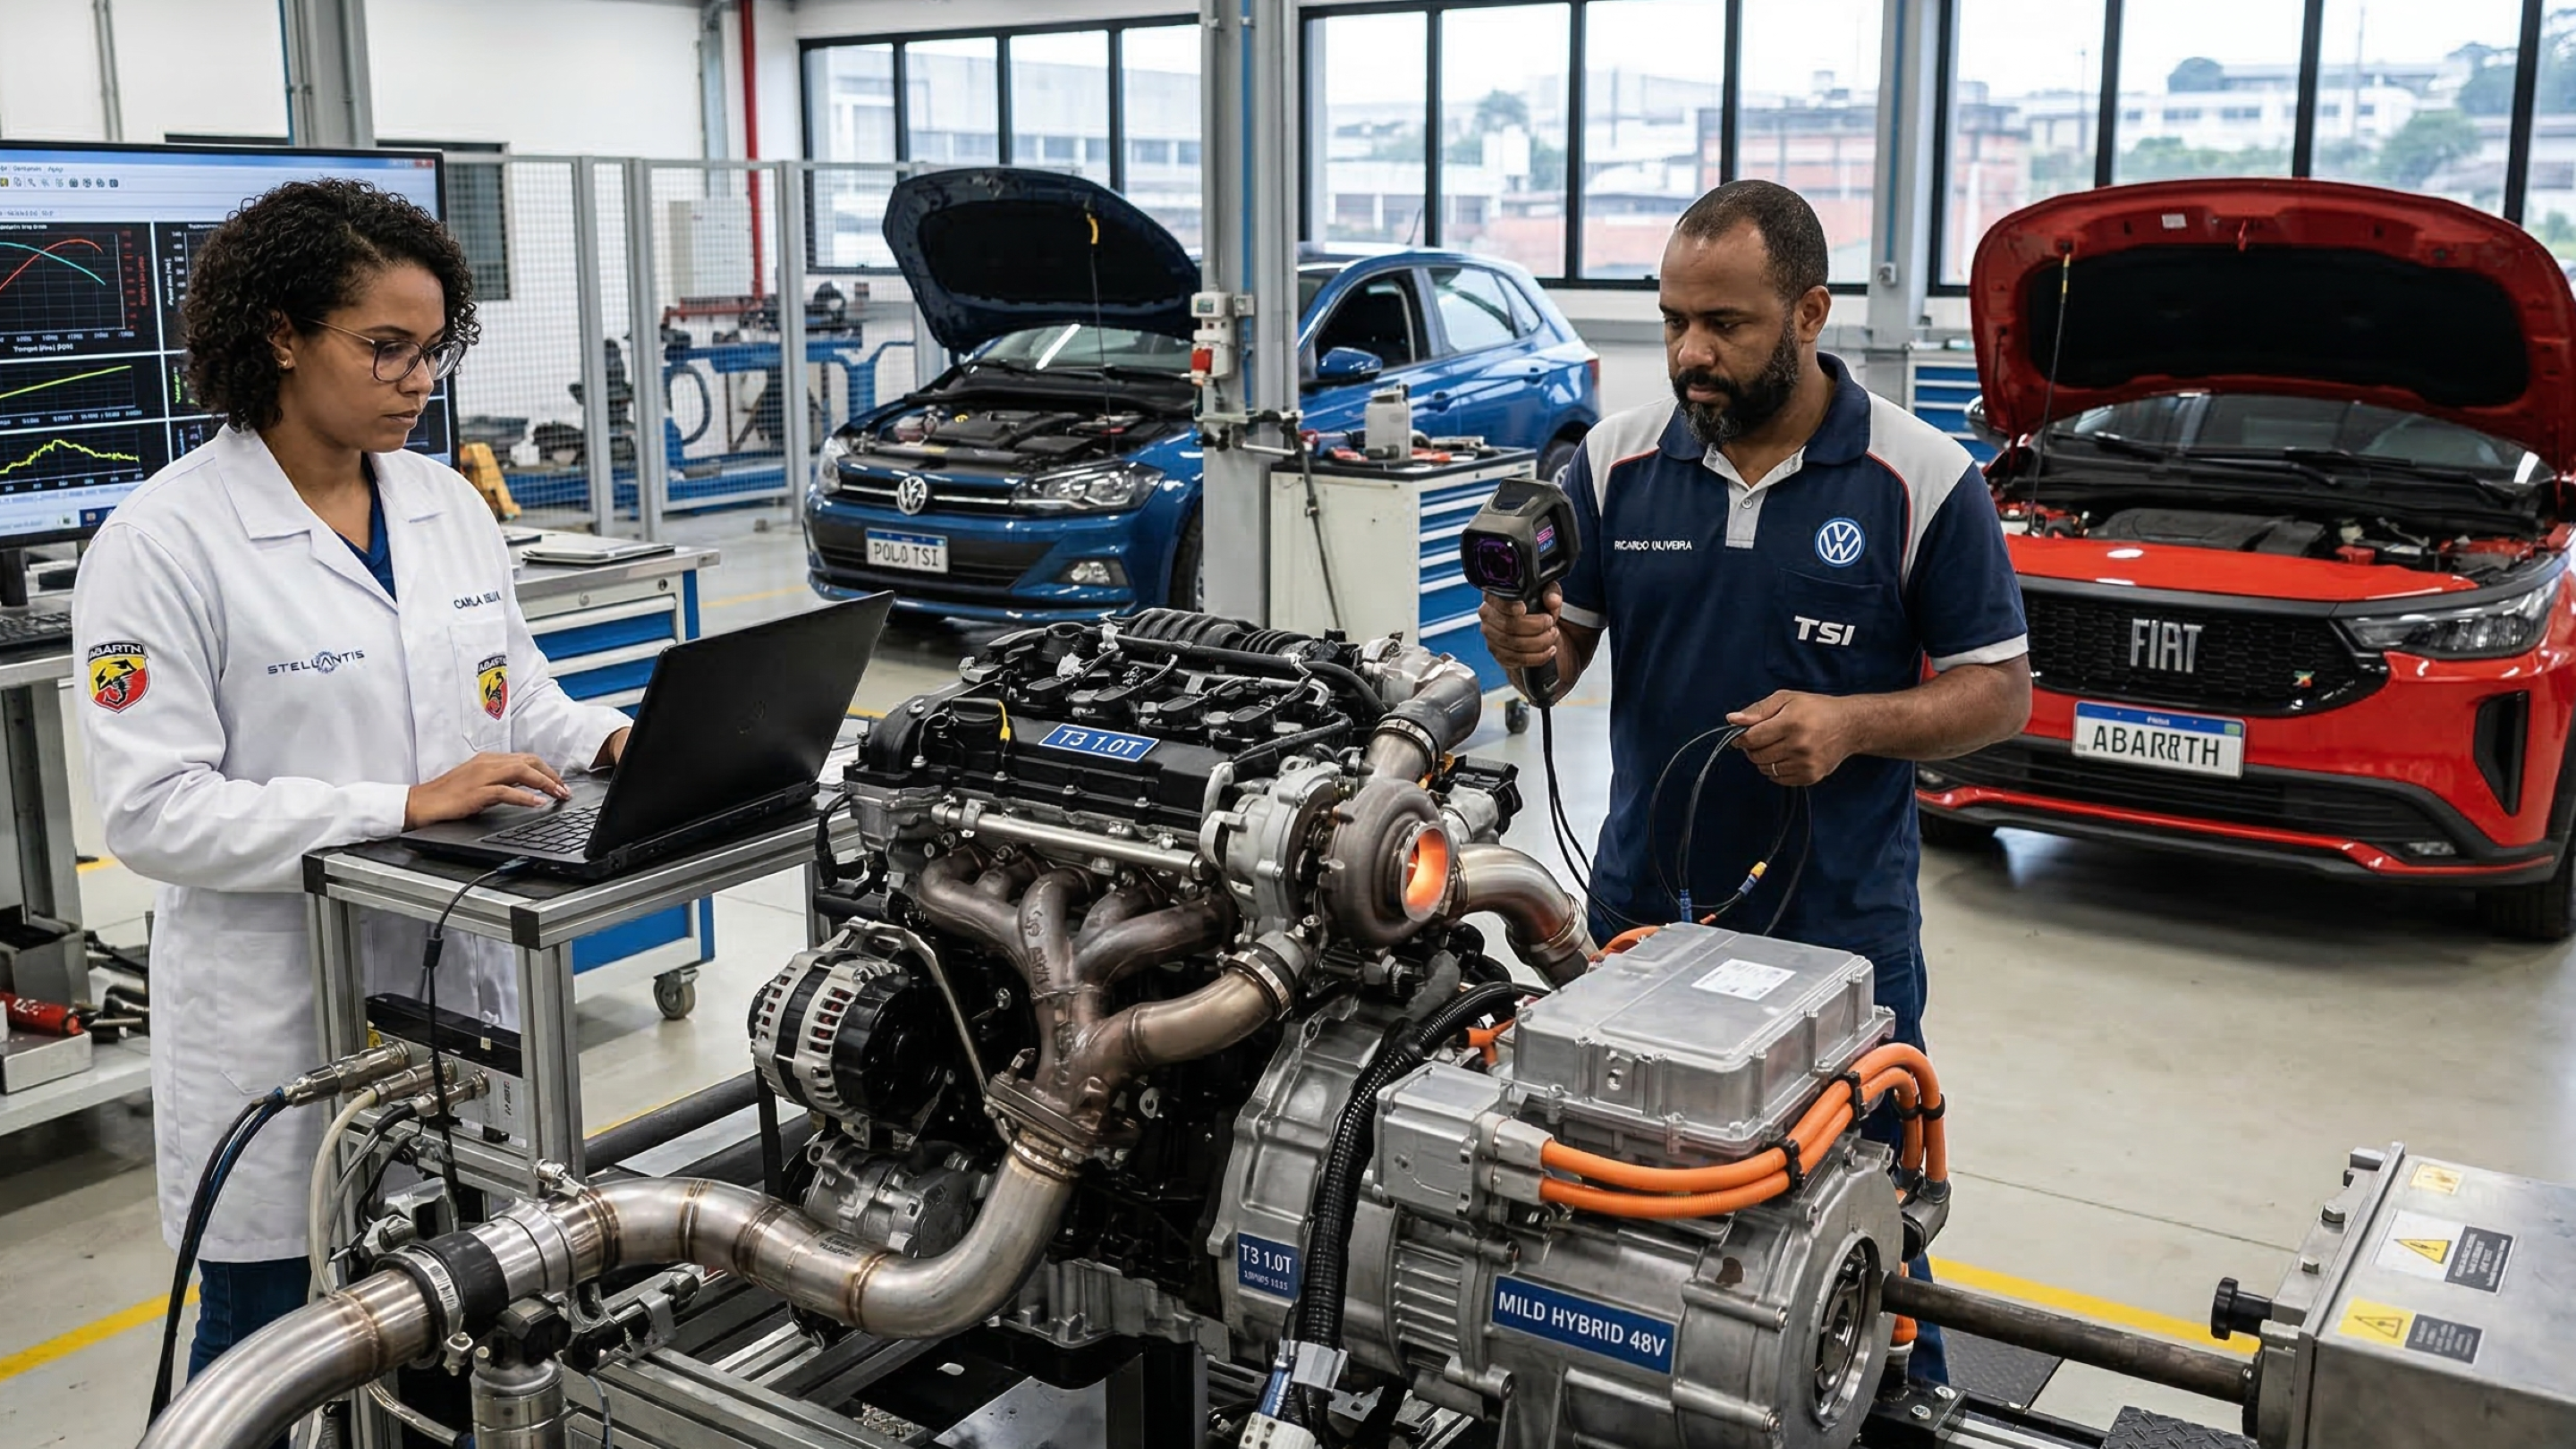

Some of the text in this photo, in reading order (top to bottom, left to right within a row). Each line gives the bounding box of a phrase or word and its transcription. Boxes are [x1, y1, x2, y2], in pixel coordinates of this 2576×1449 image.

[873, 542, 939, 567] POLO TSI
[1793, 614, 1856, 647] TSI
[2130, 618, 2203, 674] FIAT
[267, 649, 365, 674] STELLANTIS
[1058, 729, 1143, 755] T3 1.0T
[1241, 1243, 1292, 1274] T3 1.0T
[1498, 1291, 1666, 1357] MILD HYBRID 48V
